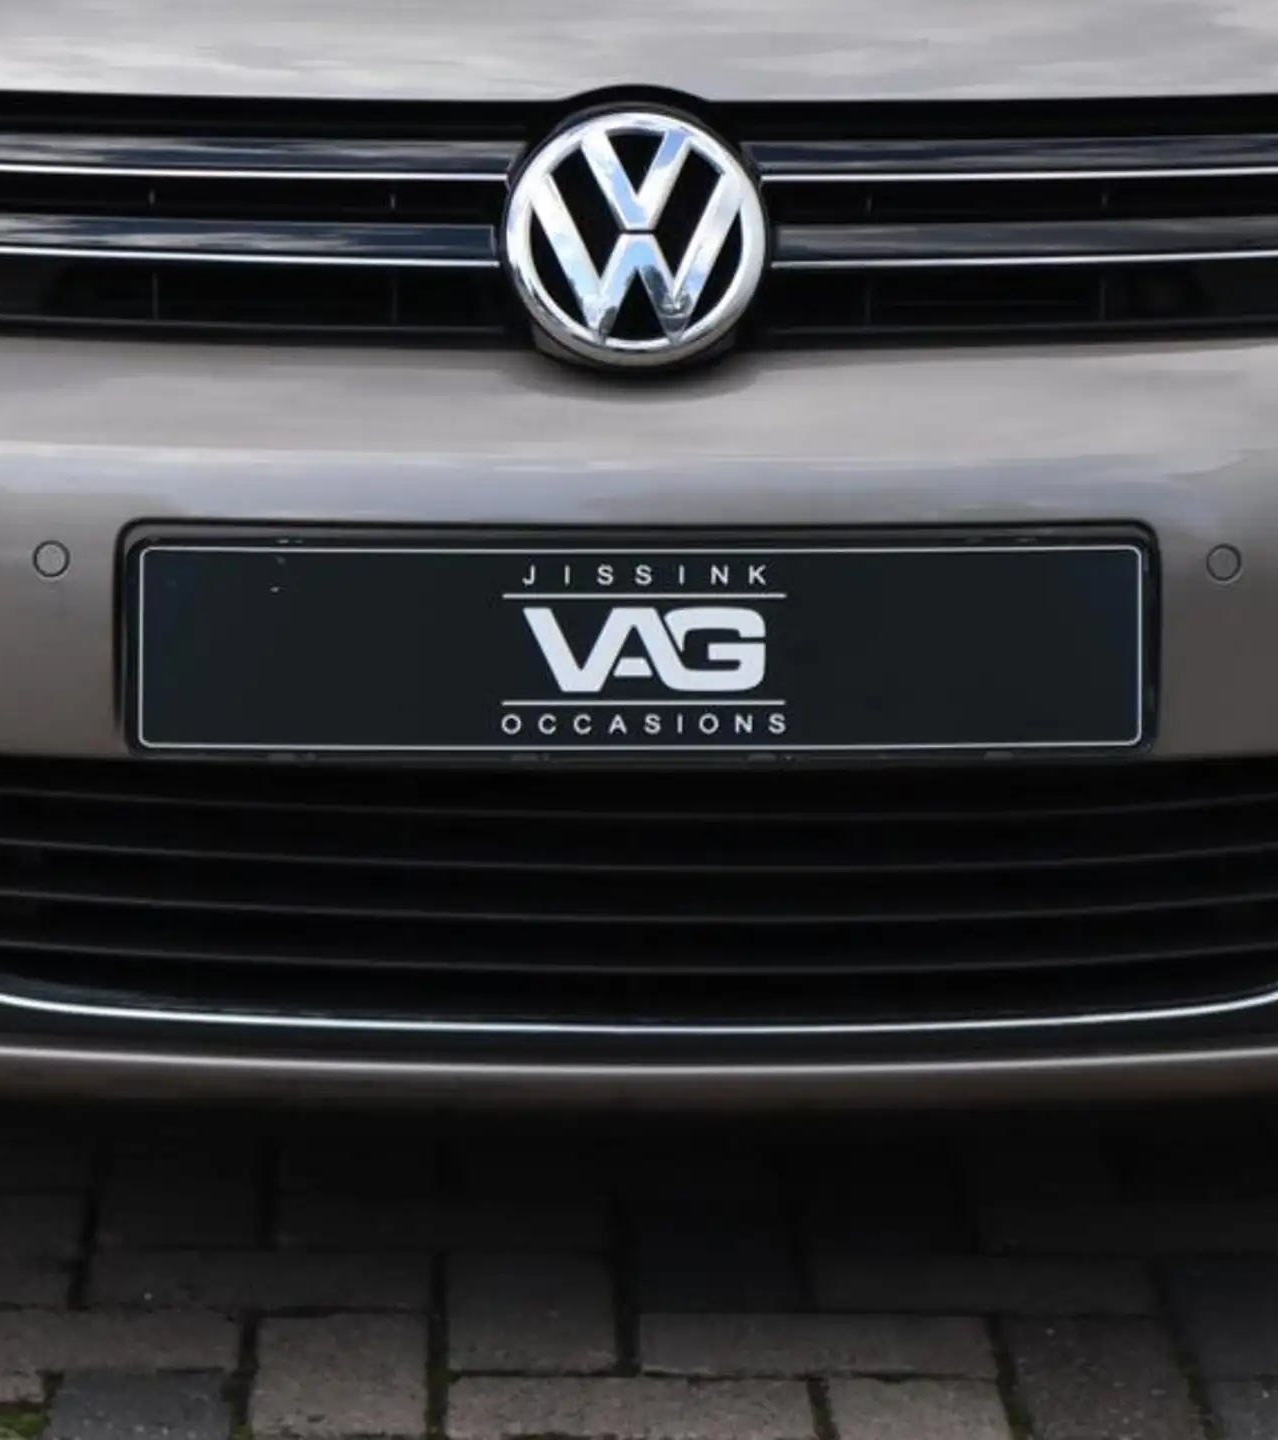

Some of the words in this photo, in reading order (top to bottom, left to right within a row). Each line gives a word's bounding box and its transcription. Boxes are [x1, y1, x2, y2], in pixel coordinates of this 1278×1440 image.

[522, 120, 745, 346] VW
[522, 563, 766, 586] JISSINK
[522, 606, 766, 693] VAG
[501, 712, 786, 735] OCCASIONS
